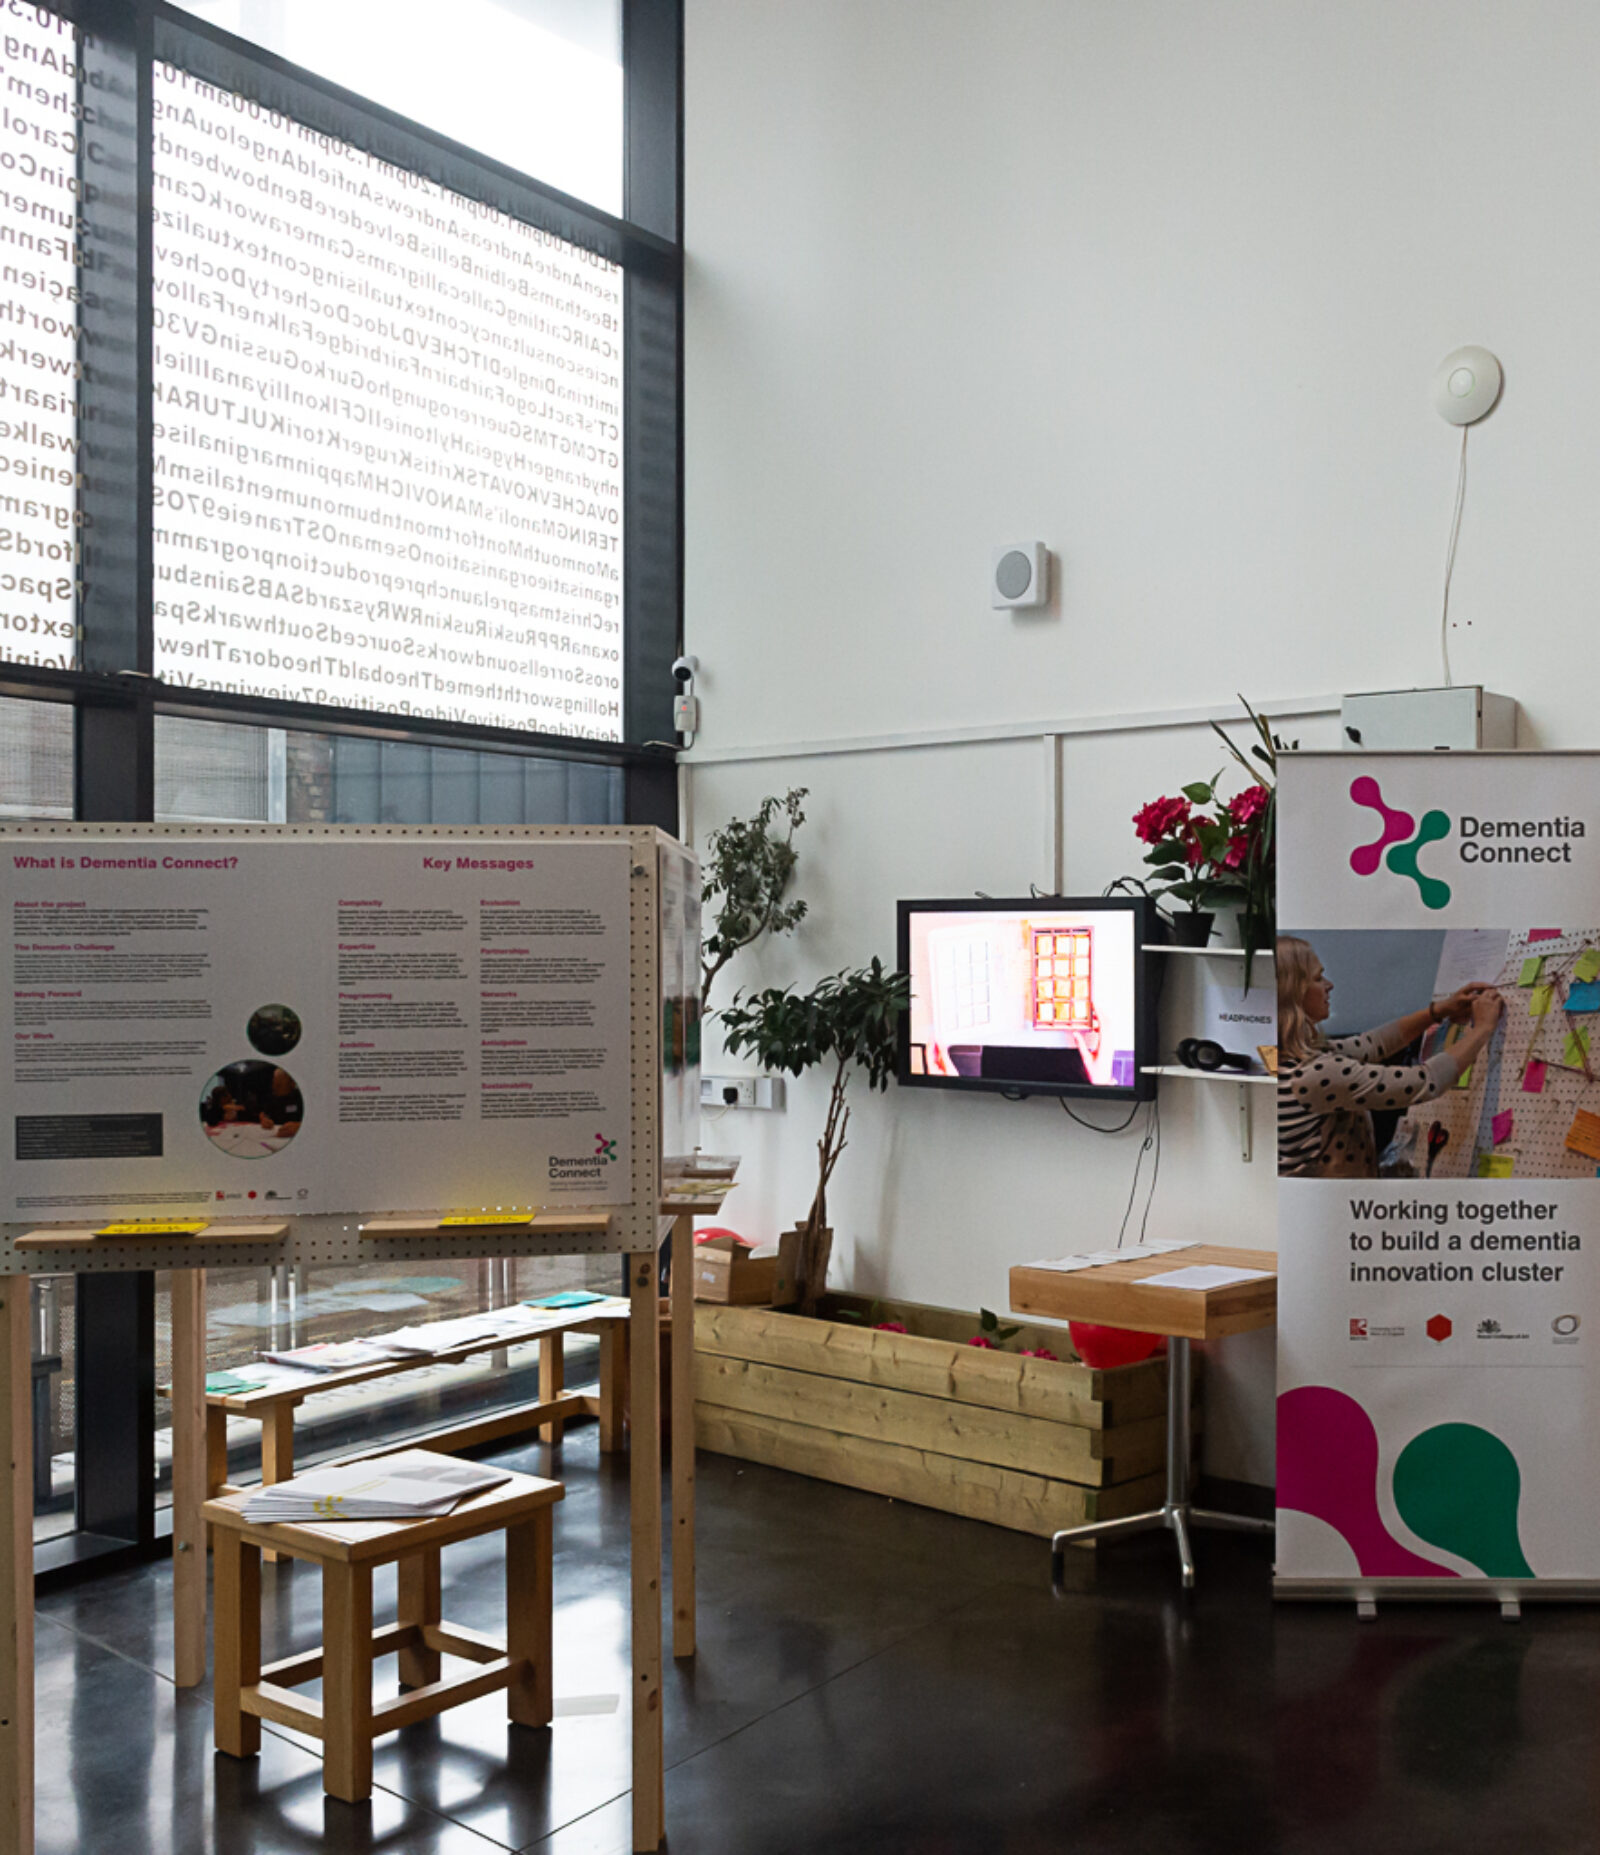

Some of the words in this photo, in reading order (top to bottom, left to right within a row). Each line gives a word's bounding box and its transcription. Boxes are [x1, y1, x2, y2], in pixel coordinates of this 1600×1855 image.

[1460, 816, 1585, 838] Dementia
[1459, 841, 1572, 864] Connect
[13, 856, 56, 869] What
[61, 856, 75, 869] is
[80, 856, 158, 869] Dementia
[162, 856, 239, 869] Connect?
[422, 857, 452, 872] Key
[457, 857, 535, 872] Messages
[56, 900, 87, 910] project
[1219, 1013, 1273, 1025] HEADPHONES
[548, 1156, 609, 1168] Dementia
[548, 1167, 602, 1179] Connect
[1349, 1200, 1449, 1225] Working
[1456, 1200, 1558, 1225] together
[1349, 1231, 1373, 1251] to
[1381, 1230, 1440, 1251] build
[1448, 1234, 1462, 1251] a
[1469, 1230, 1581, 1251] dementia
[1350, 1261, 1473, 1282] innovation
[1481, 1261, 1564, 1282] cluster
